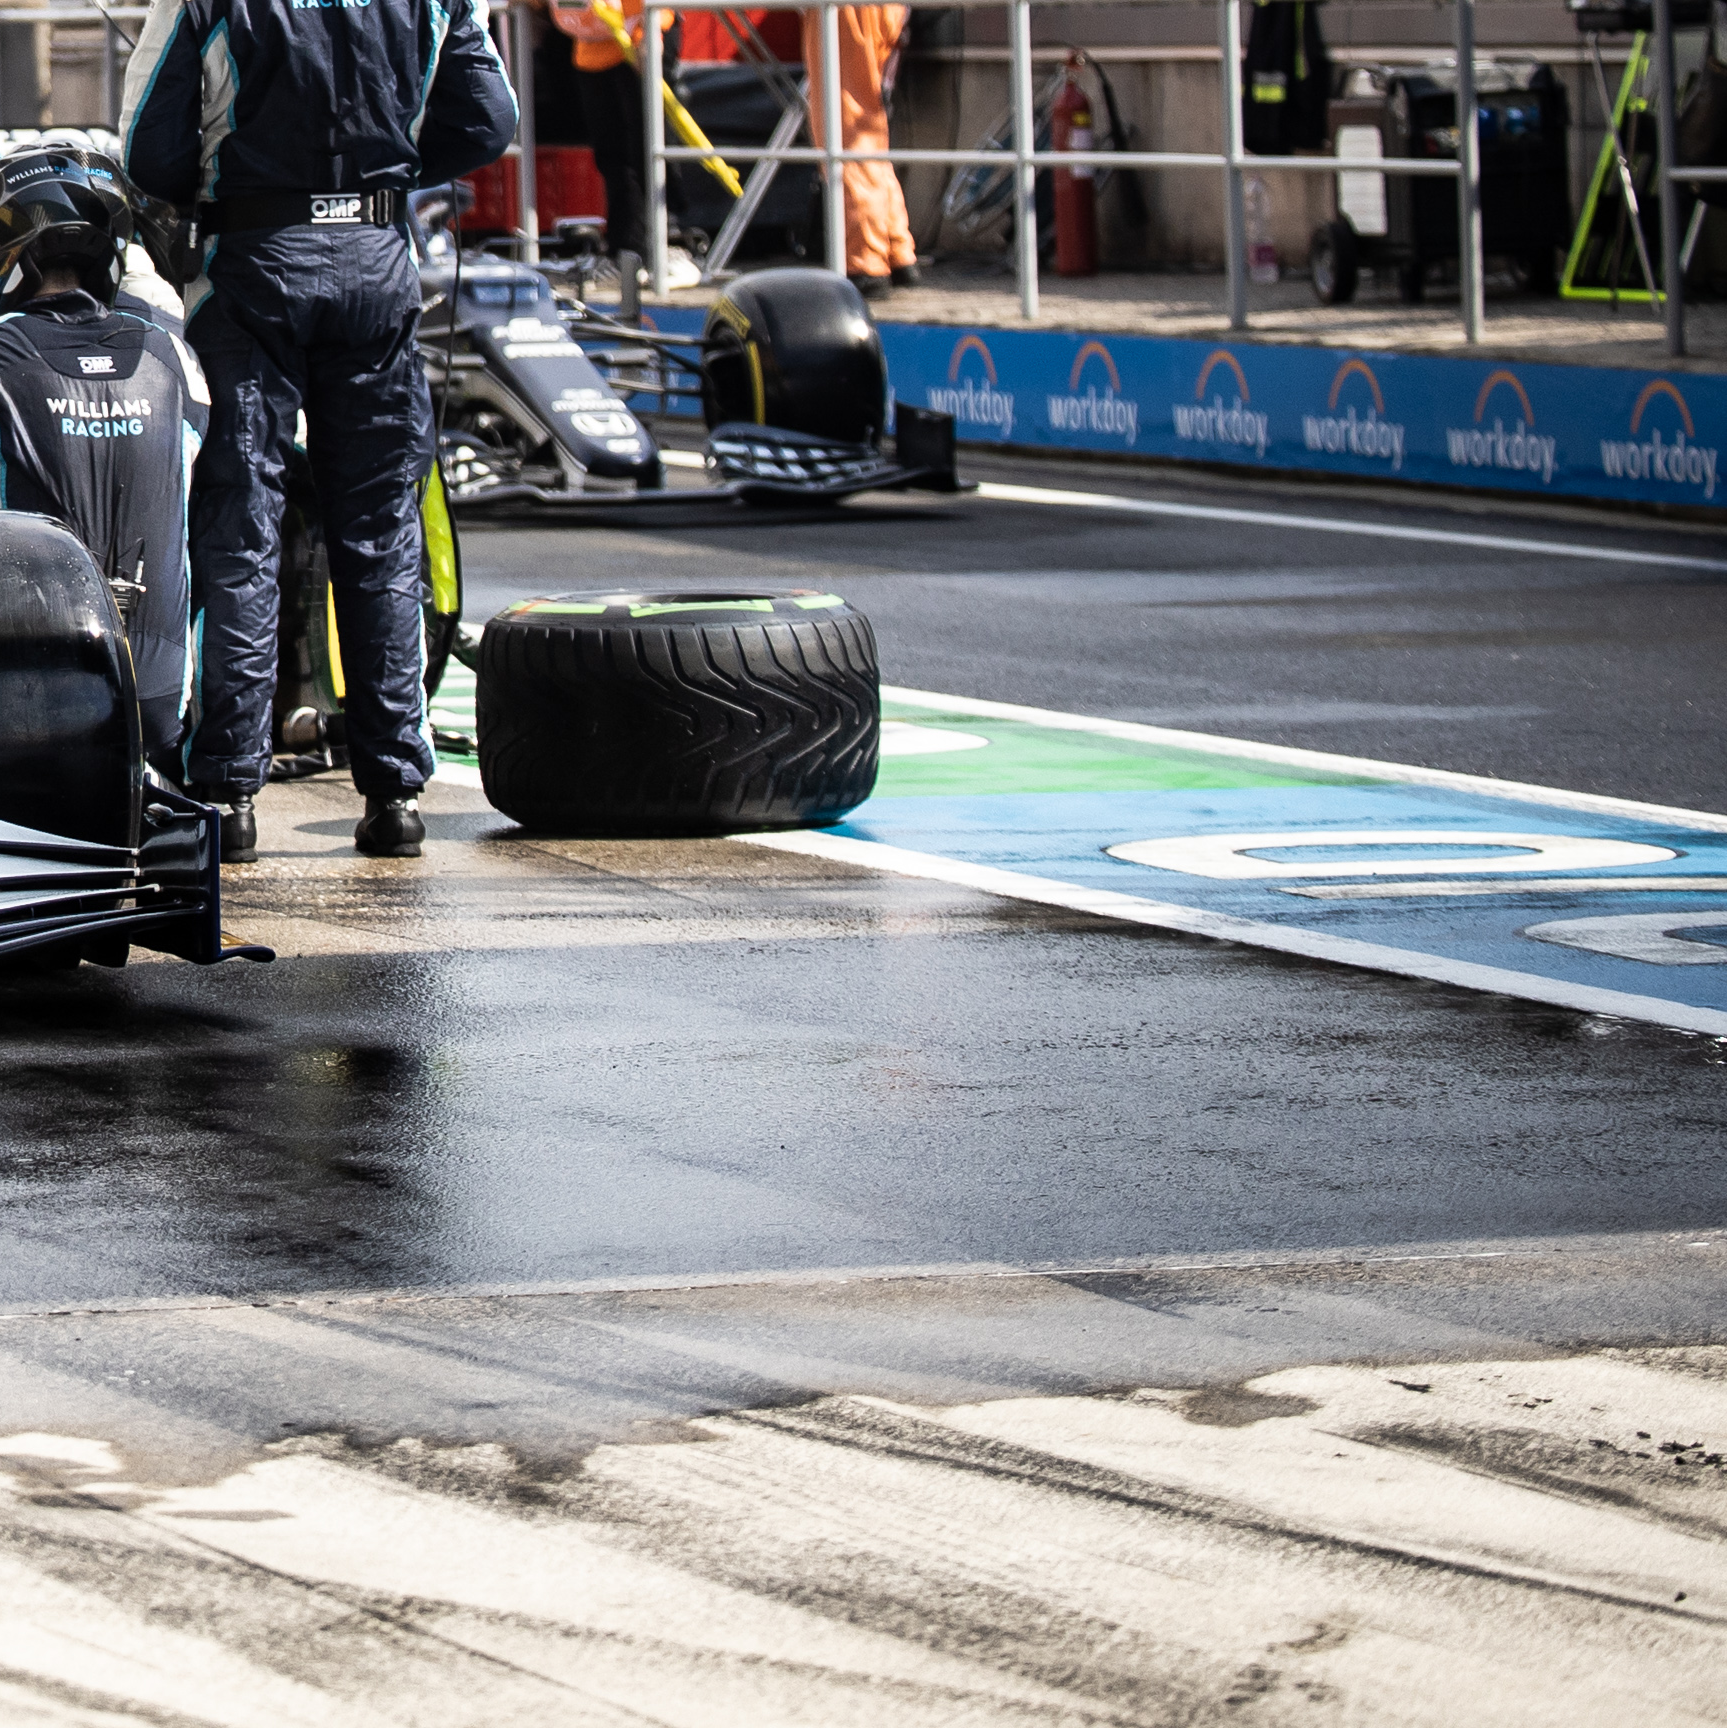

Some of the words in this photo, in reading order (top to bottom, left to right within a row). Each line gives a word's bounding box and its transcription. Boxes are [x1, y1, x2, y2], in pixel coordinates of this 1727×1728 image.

[6, 165, 54, 184] WILLIAMS
[311, 199, 361, 218] OMP
[80, 359, 114, 371] OMP
[47, 398, 152, 418] WILLIAMS
[61, 418, 144, 438] RACING
[927, 378, 1015, 439] workday
[1049, 385, 1139, 447] workday
[1172, 394, 1269, 459] workday
[1302, 405, 1406, 471] workday
[1447, 416, 1558, 484] workday
[1600, 427, 1720, 500] workday
